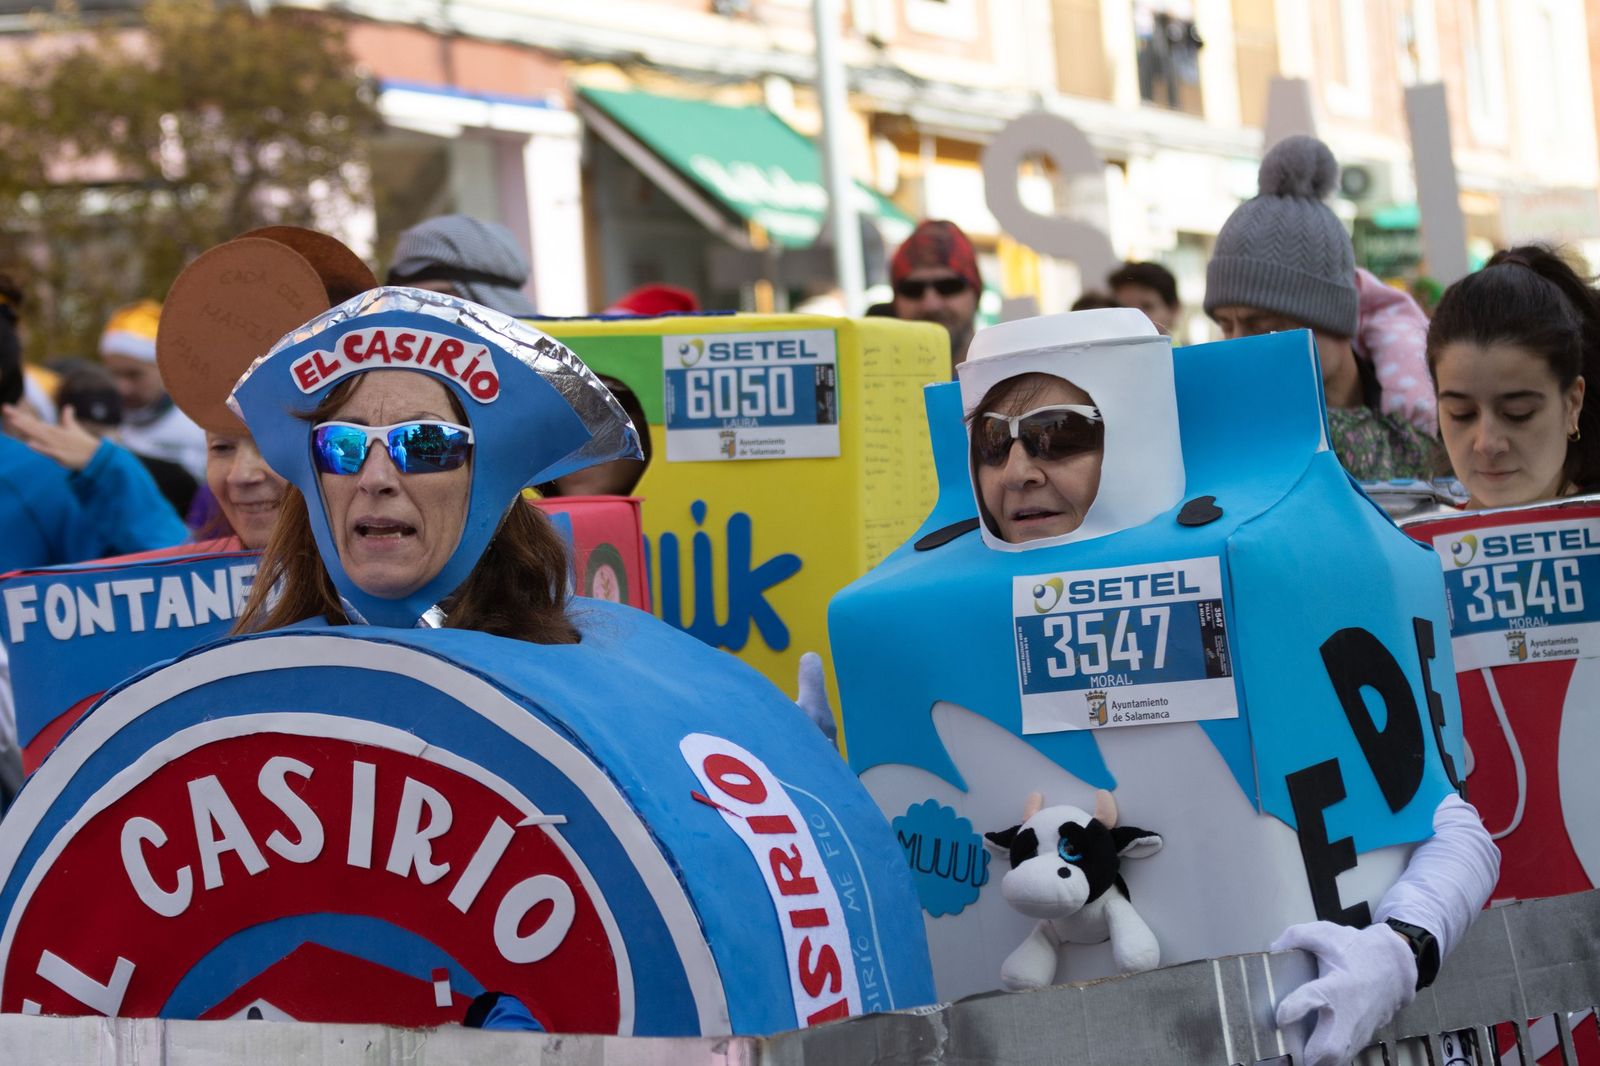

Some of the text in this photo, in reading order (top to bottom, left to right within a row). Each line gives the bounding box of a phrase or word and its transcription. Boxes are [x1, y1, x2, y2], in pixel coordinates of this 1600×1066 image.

[708, 339, 818, 362] SETEL
[294, 330, 499, 399] EL CASIRÍO
[686, 366, 795, 419] 6050
[722, 417, 760, 429] LAURA
[739, 437, 786, 448] Ayuntamiento
[739, 447, 786, 456] de Salamanca
[1482, 528, 1600, 558] SETEL
[1069, 571, 1200, 605] SETEL
[1462, 558, 1585, 622] 3546
[1508, 616, 1549, 629] MORAL
[1043, 606, 1170, 678] 3547
[1530, 637, 1578, 648] Ayuntamiento
[1532, 648, 1580, 658] de Salamanca
[1090, 673, 1133, 688] MORAL
[1111, 698, 1168, 711] Ayuntamiento
[1113, 711, 1170, 722] de Salamanca
[120, 756, 576, 964] CASIRÍO
[898, 829, 986, 888] MUUUU
[836, 872, 861, 912] ME
